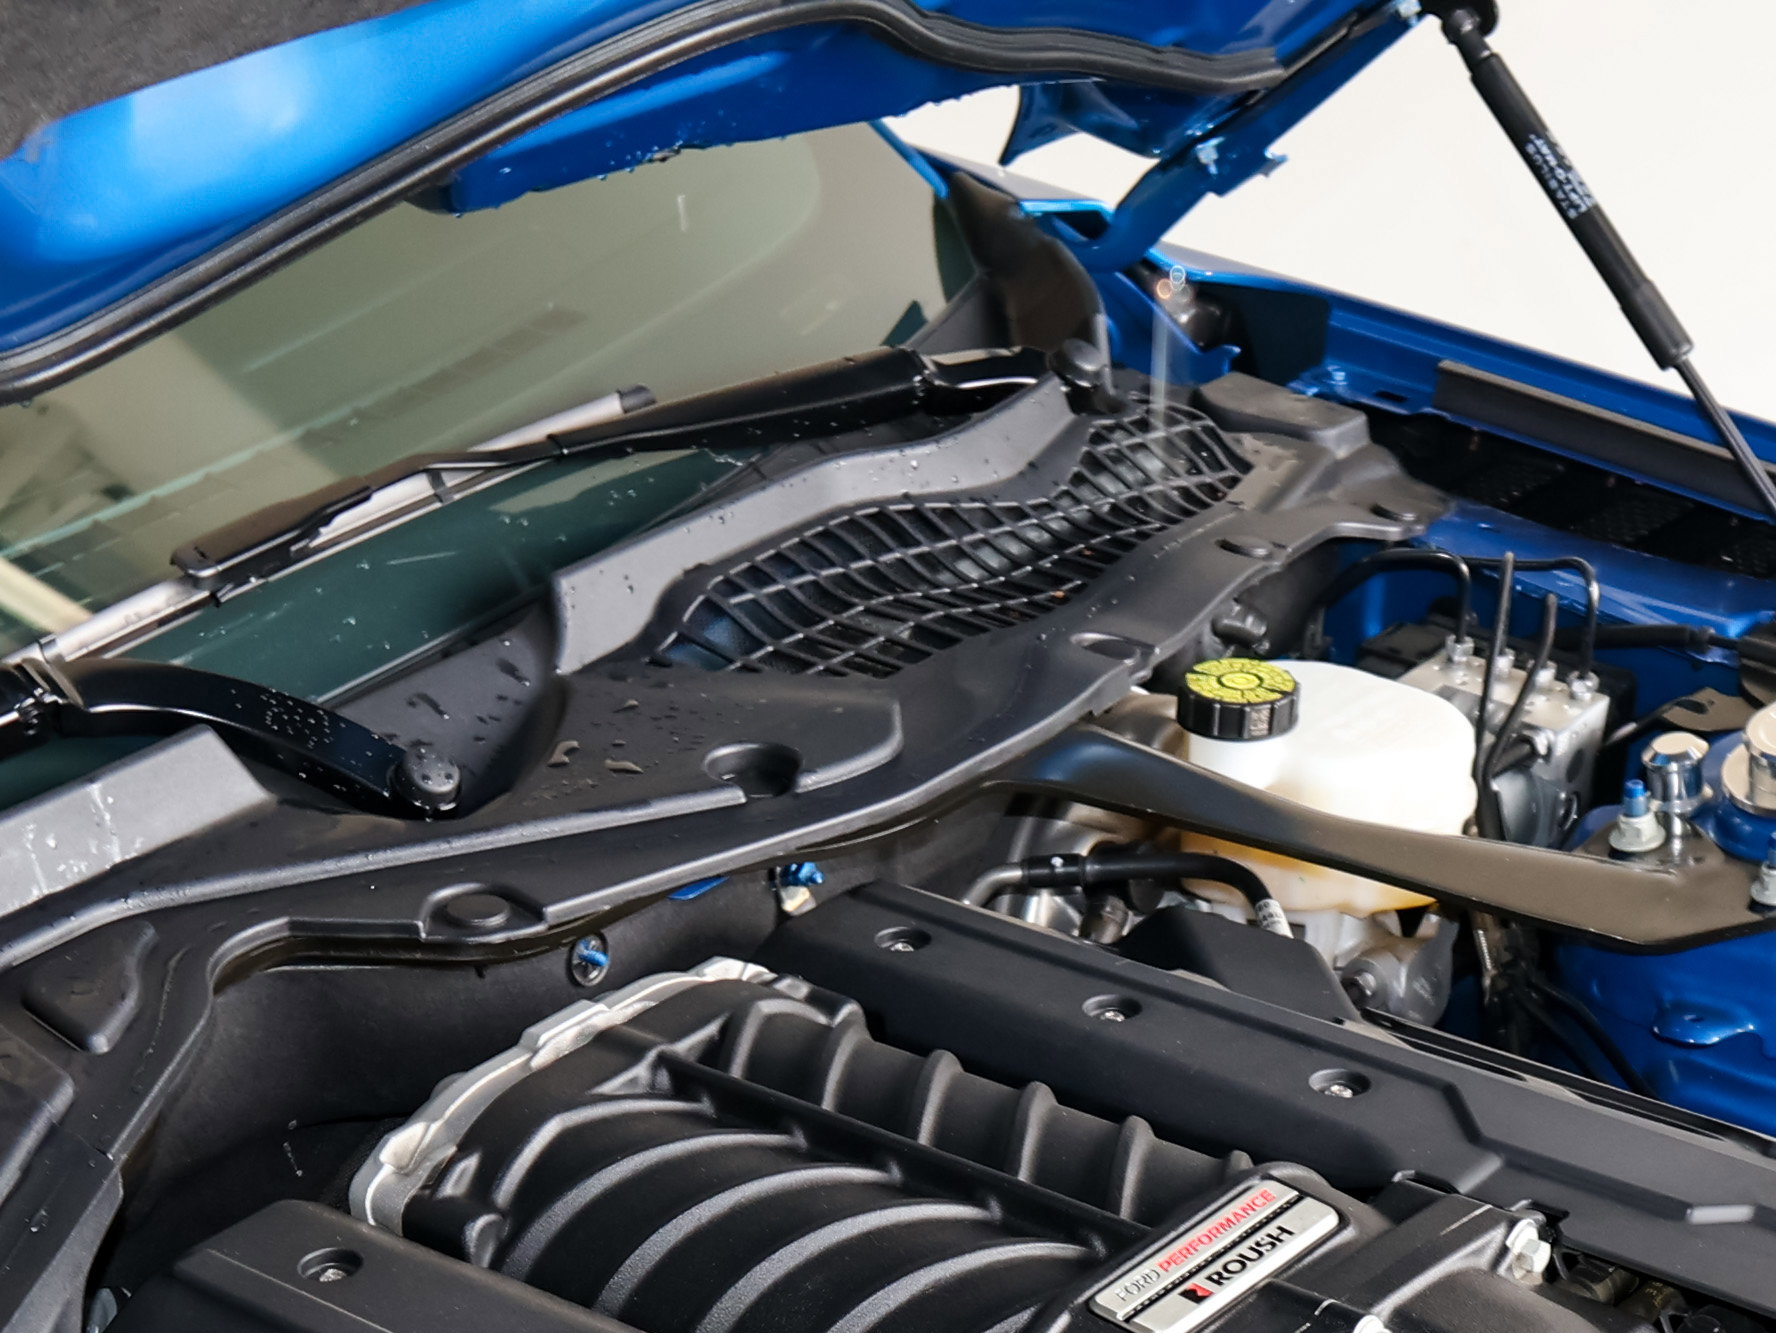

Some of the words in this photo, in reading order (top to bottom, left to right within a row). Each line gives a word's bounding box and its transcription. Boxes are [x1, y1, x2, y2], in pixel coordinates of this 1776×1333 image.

[1113, 1268, 1162, 1303] FORD
[1156, 1188, 1277, 1273] PERFORMANCE
[1205, 1225, 1298, 1287] ROUSH
